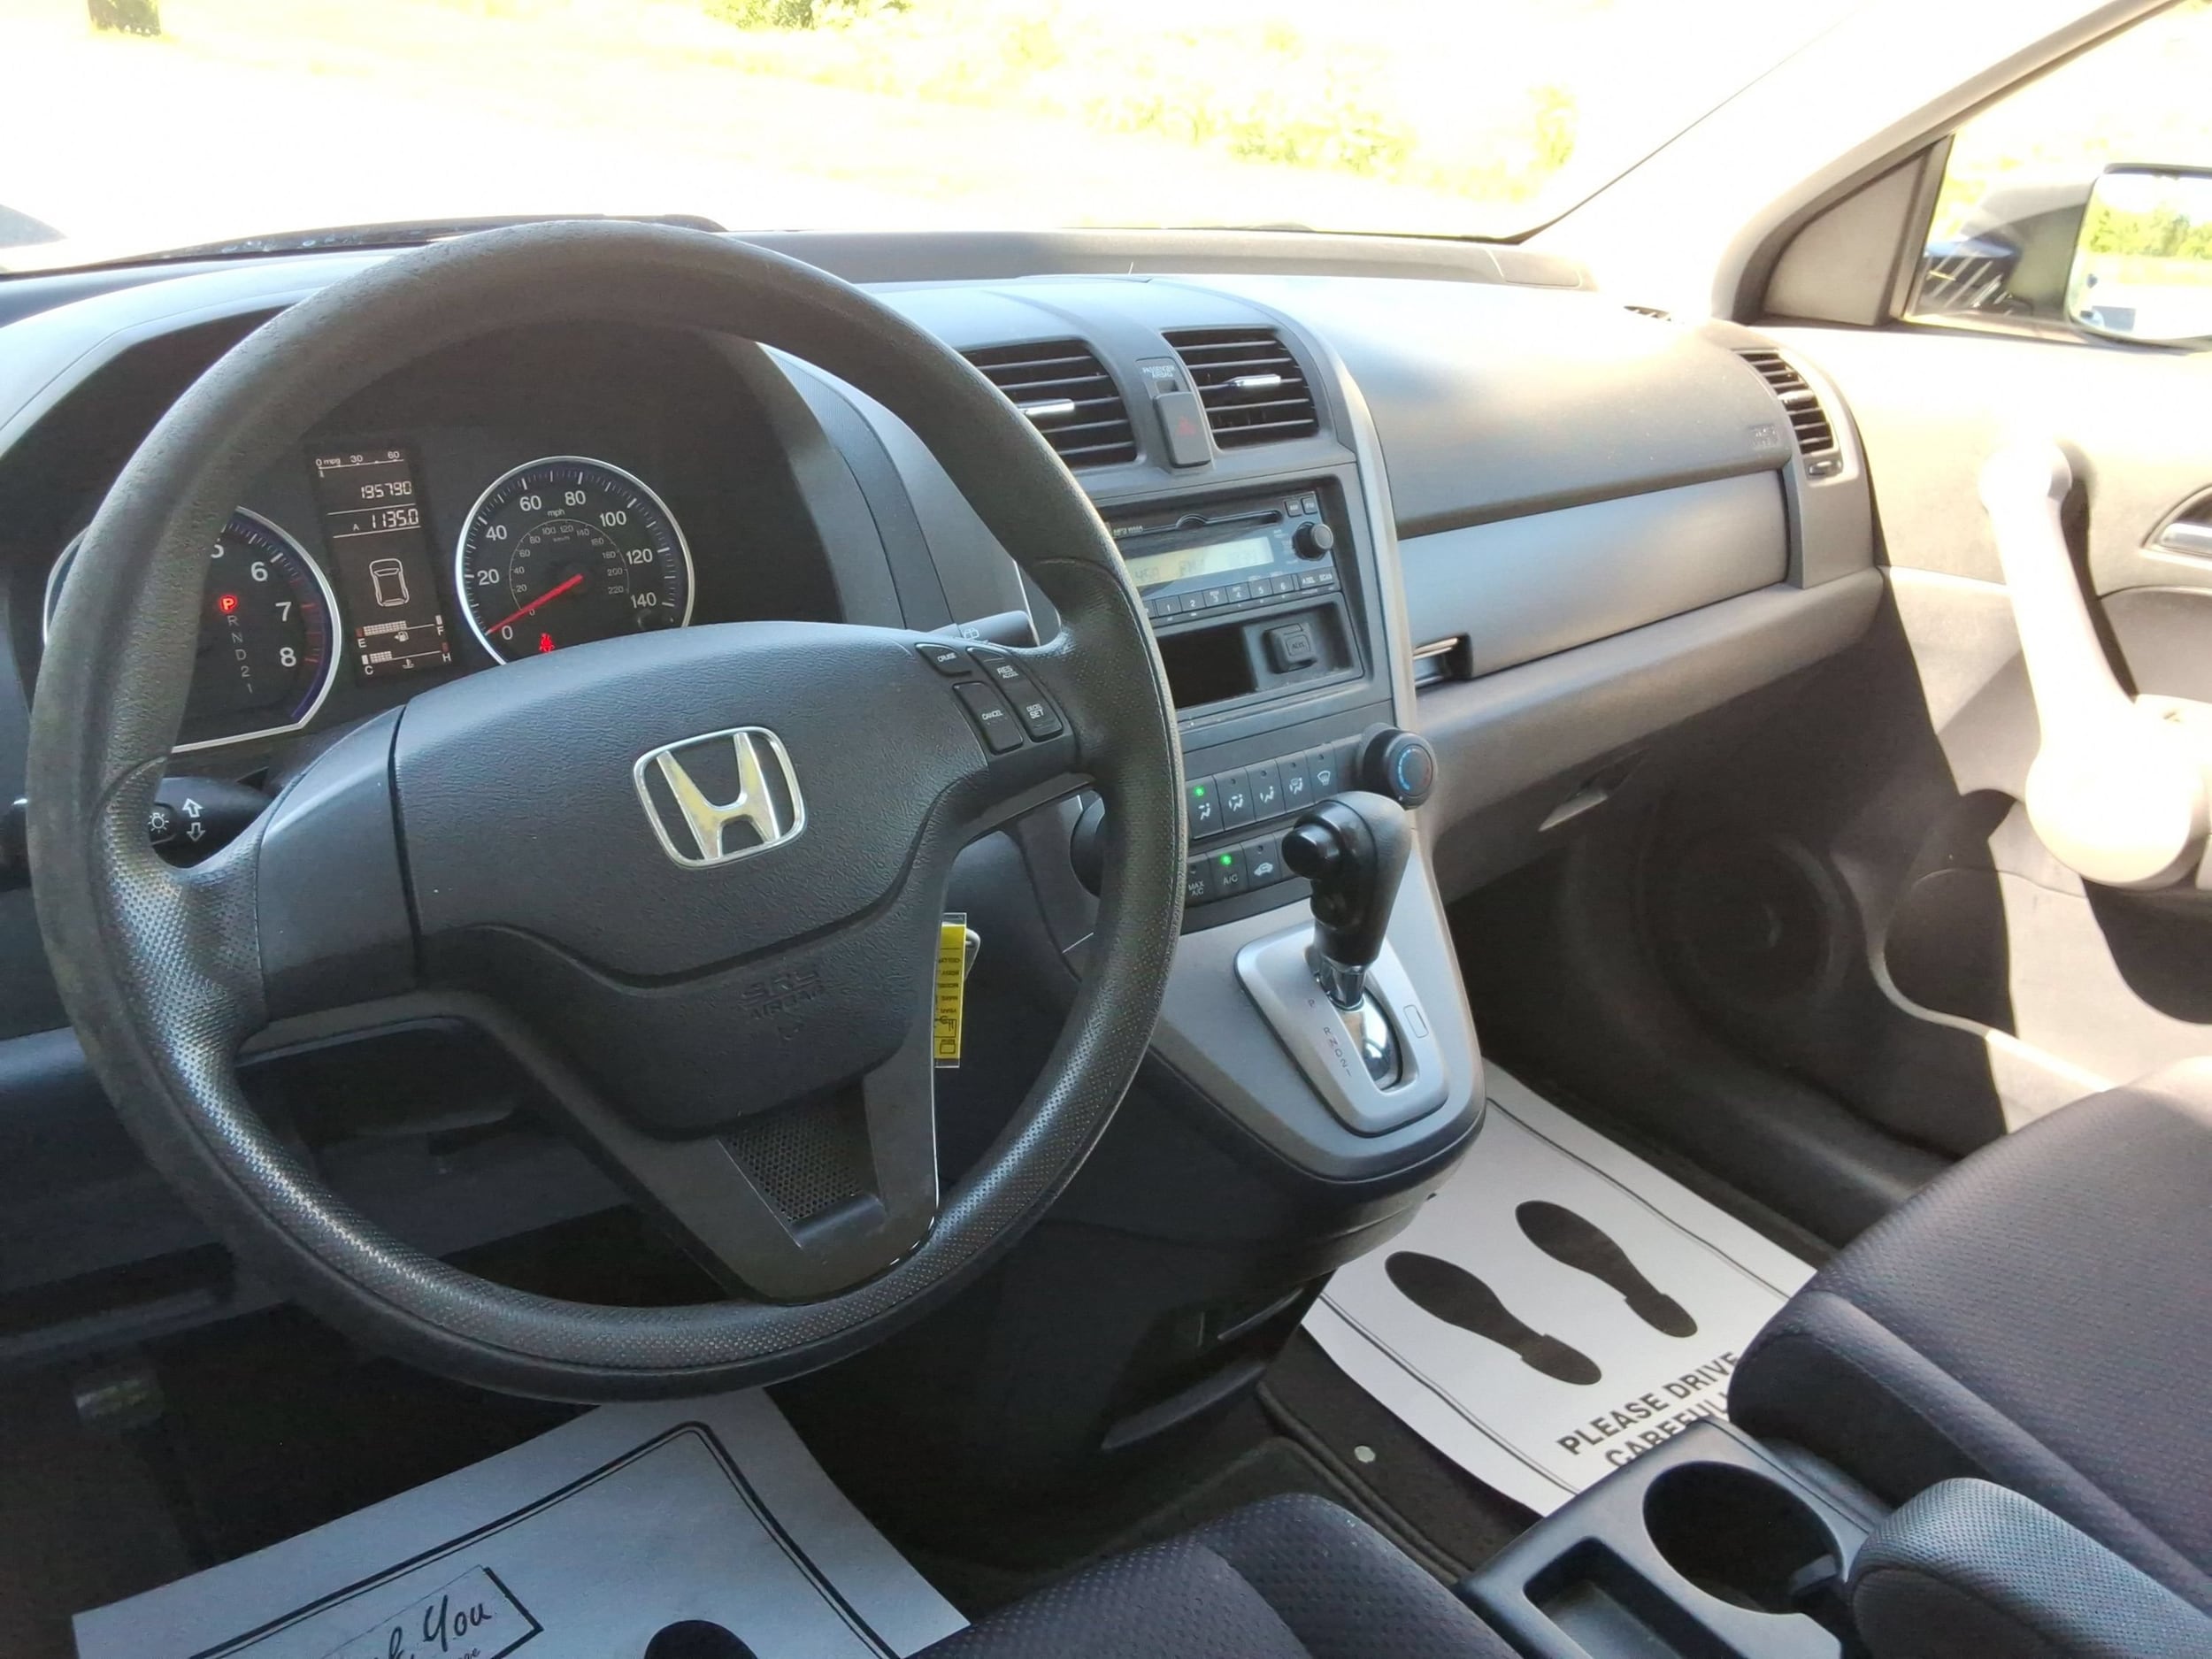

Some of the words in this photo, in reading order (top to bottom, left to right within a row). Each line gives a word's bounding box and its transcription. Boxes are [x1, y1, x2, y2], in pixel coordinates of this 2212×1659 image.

[323, 457, 342, 466] mpg
[349, 454, 364, 464] 30
[387, 450, 401, 459] 60
[360, 480, 413, 499] 195790
[518, 495, 542, 512] 60
[564, 489, 587, 507] 80
[547, 508, 565, 518] mph
[598, 511, 627, 528] 100
[485, 524, 508, 541] 40
[541, 526, 557, 536] 100
[626, 548, 654, 565] 120
[250, 561, 268, 582] 6
[477, 568, 500, 586] 20
[513, 565, 526, 576] 40
[222, 597, 235, 611] P
[630, 591, 657, 610] 140
[274, 602, 292, 622] 7
[227, 615, 239, 626] R
[231, 632, 243, 643] N
[436, 626, 444, 636] F
[500, 625, 514, 641] 0
[357, 638, 367, 649] E
[234, 648, 247, 661] D
[279, 647, 297, 667] 8
[442, 653, 452, 663] H
[240, 665, 250, 678] 2
[364, 665, 374, 675] C
[1188, 880, 1205, 891] MAX
[1223, 873, 1239, 886] A/C
[1323, 1026, 1332, 1035] R
[1555, 1392, 1671, 1456] PLEASE
[1661, 1351, 1739, 1400] DRIVE
[423, 1594, 492, 1653] You
